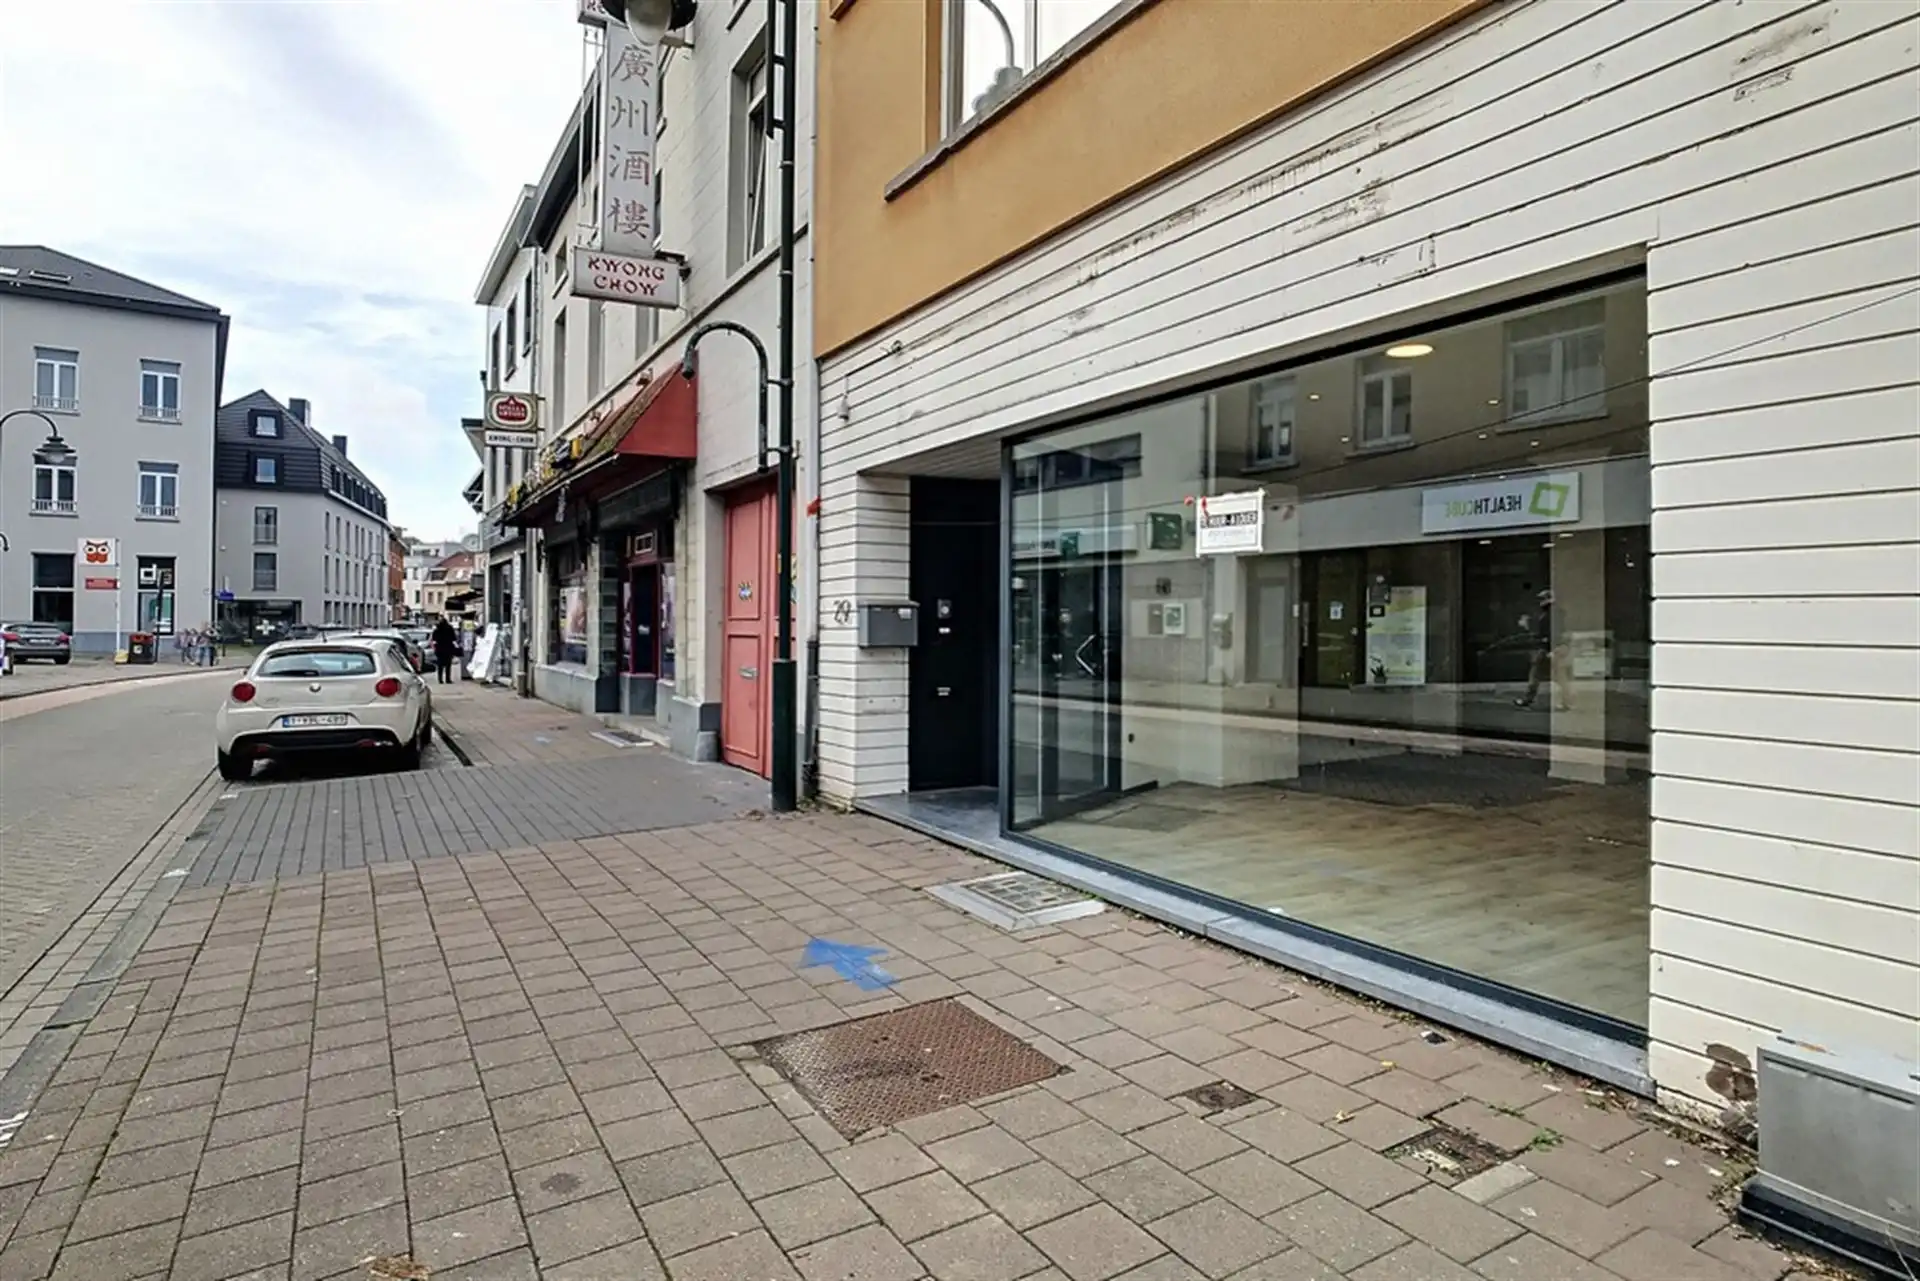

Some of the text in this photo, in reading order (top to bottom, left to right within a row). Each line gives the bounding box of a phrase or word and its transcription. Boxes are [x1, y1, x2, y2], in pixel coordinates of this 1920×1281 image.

[608, 44, 653, 239] 廣州酒樓
[588, 255, 665, 282] KWONG
[594, 275, 659, 297] CHOW
[833, 600, 852, 625] 29
